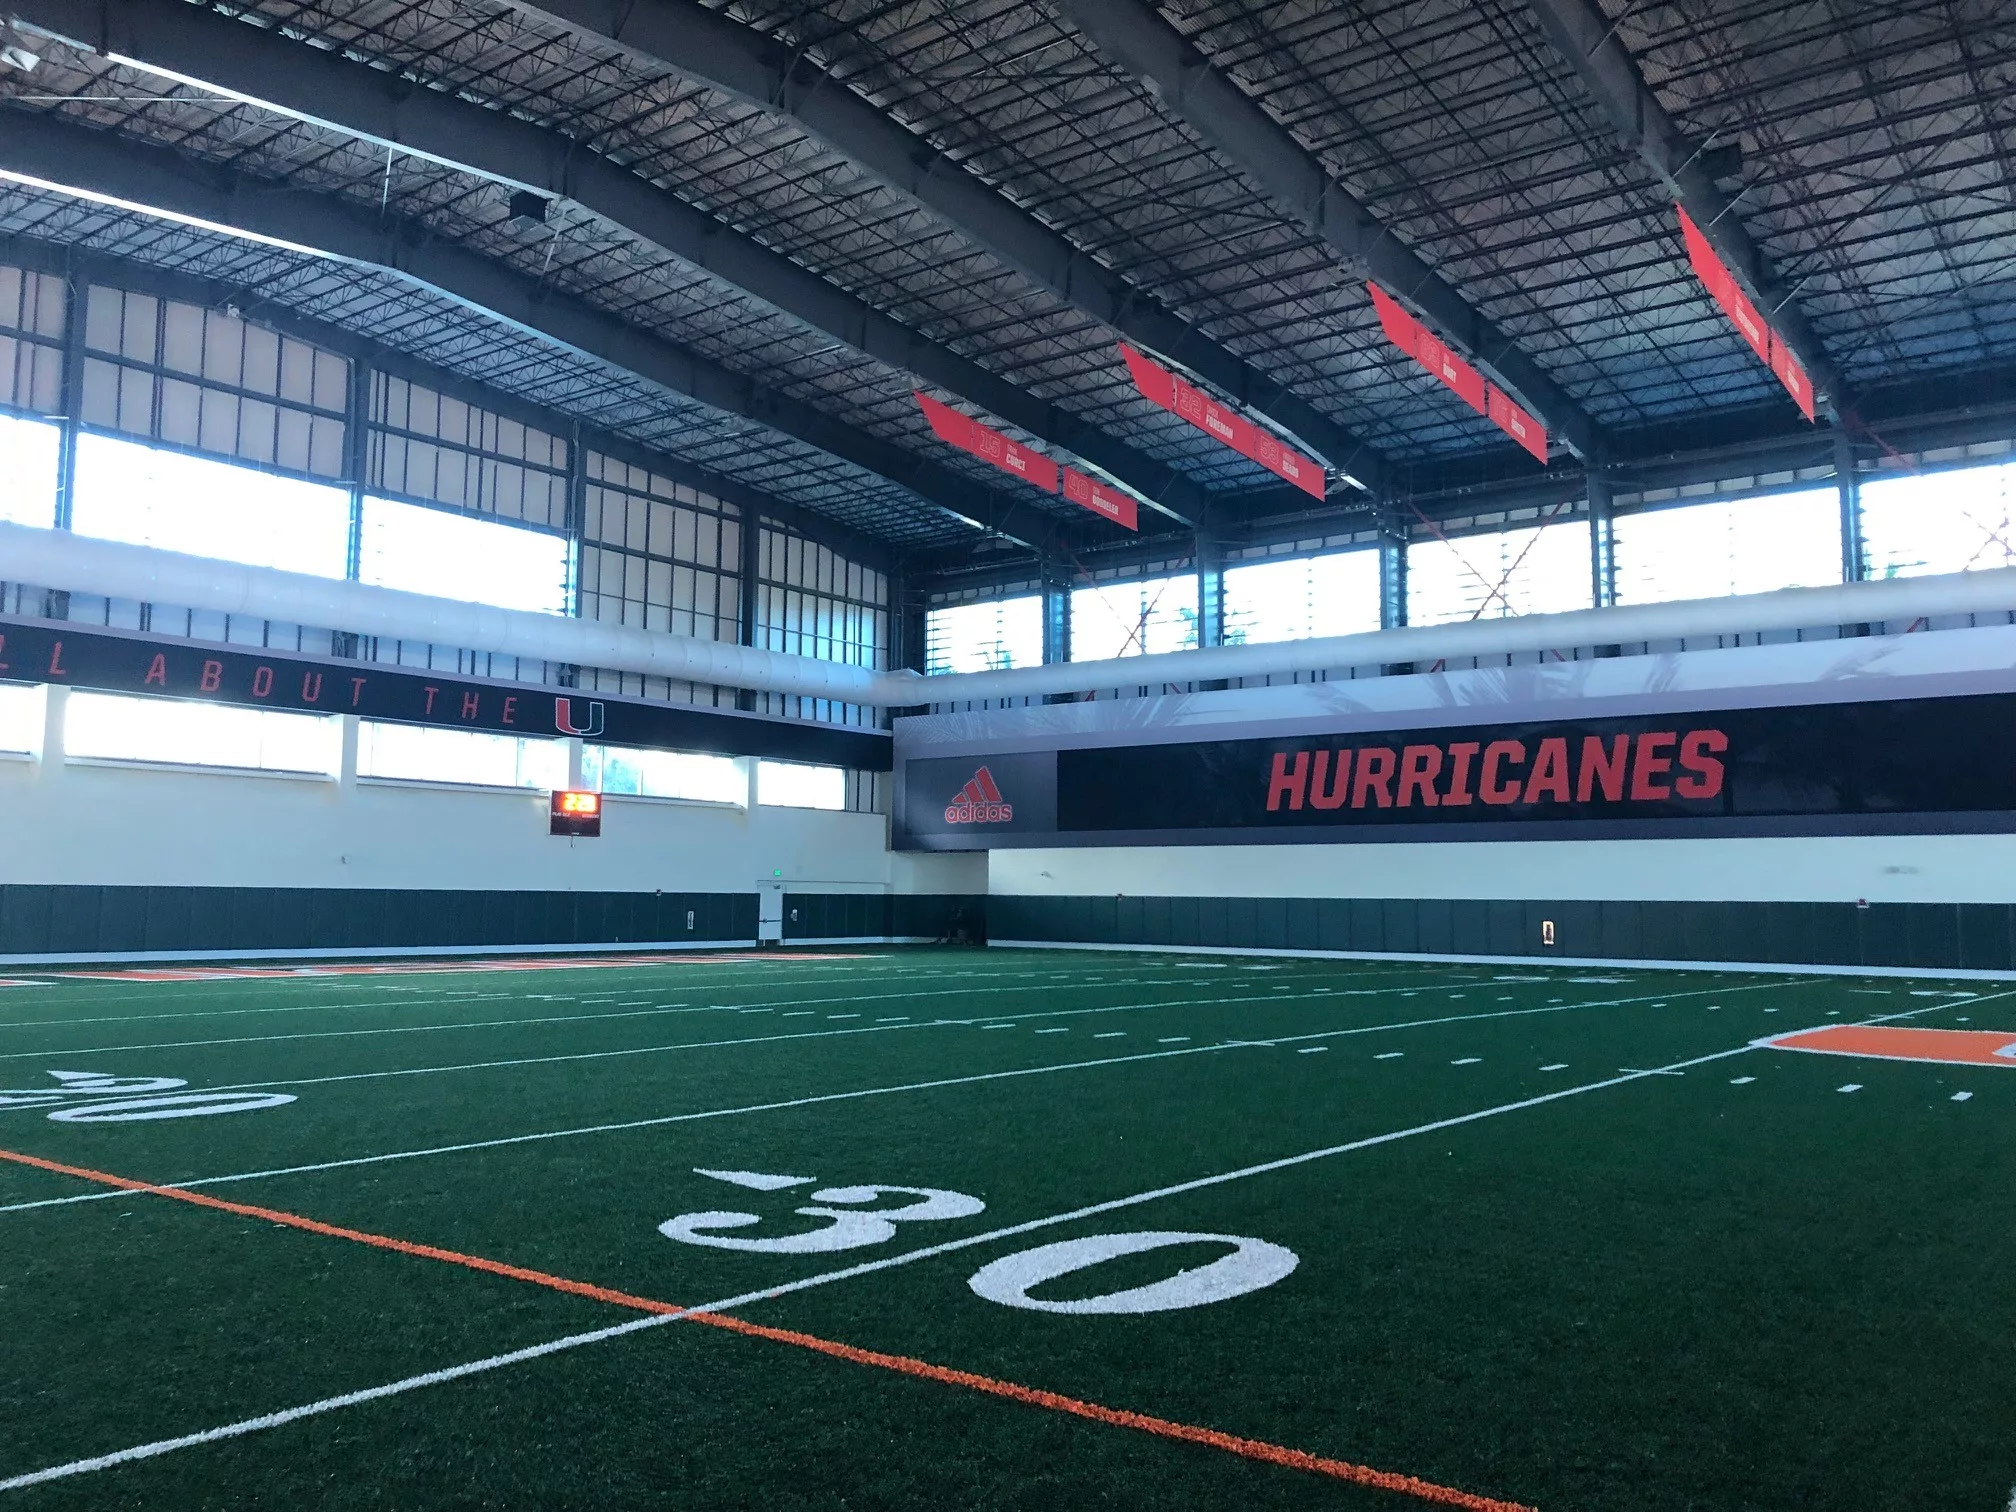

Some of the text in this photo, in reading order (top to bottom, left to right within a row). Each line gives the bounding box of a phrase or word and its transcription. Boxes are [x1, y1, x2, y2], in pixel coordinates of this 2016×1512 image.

[145, 653, 367, 707] ABOUT
[424, 686, 518, 724] THE
[555, 697, 604, 736] U
[1266, 729, 1729, 811] HURRICANES
[945, 801, 1013, 823] adidas
[658, 1185, 1300, 1315] 30
